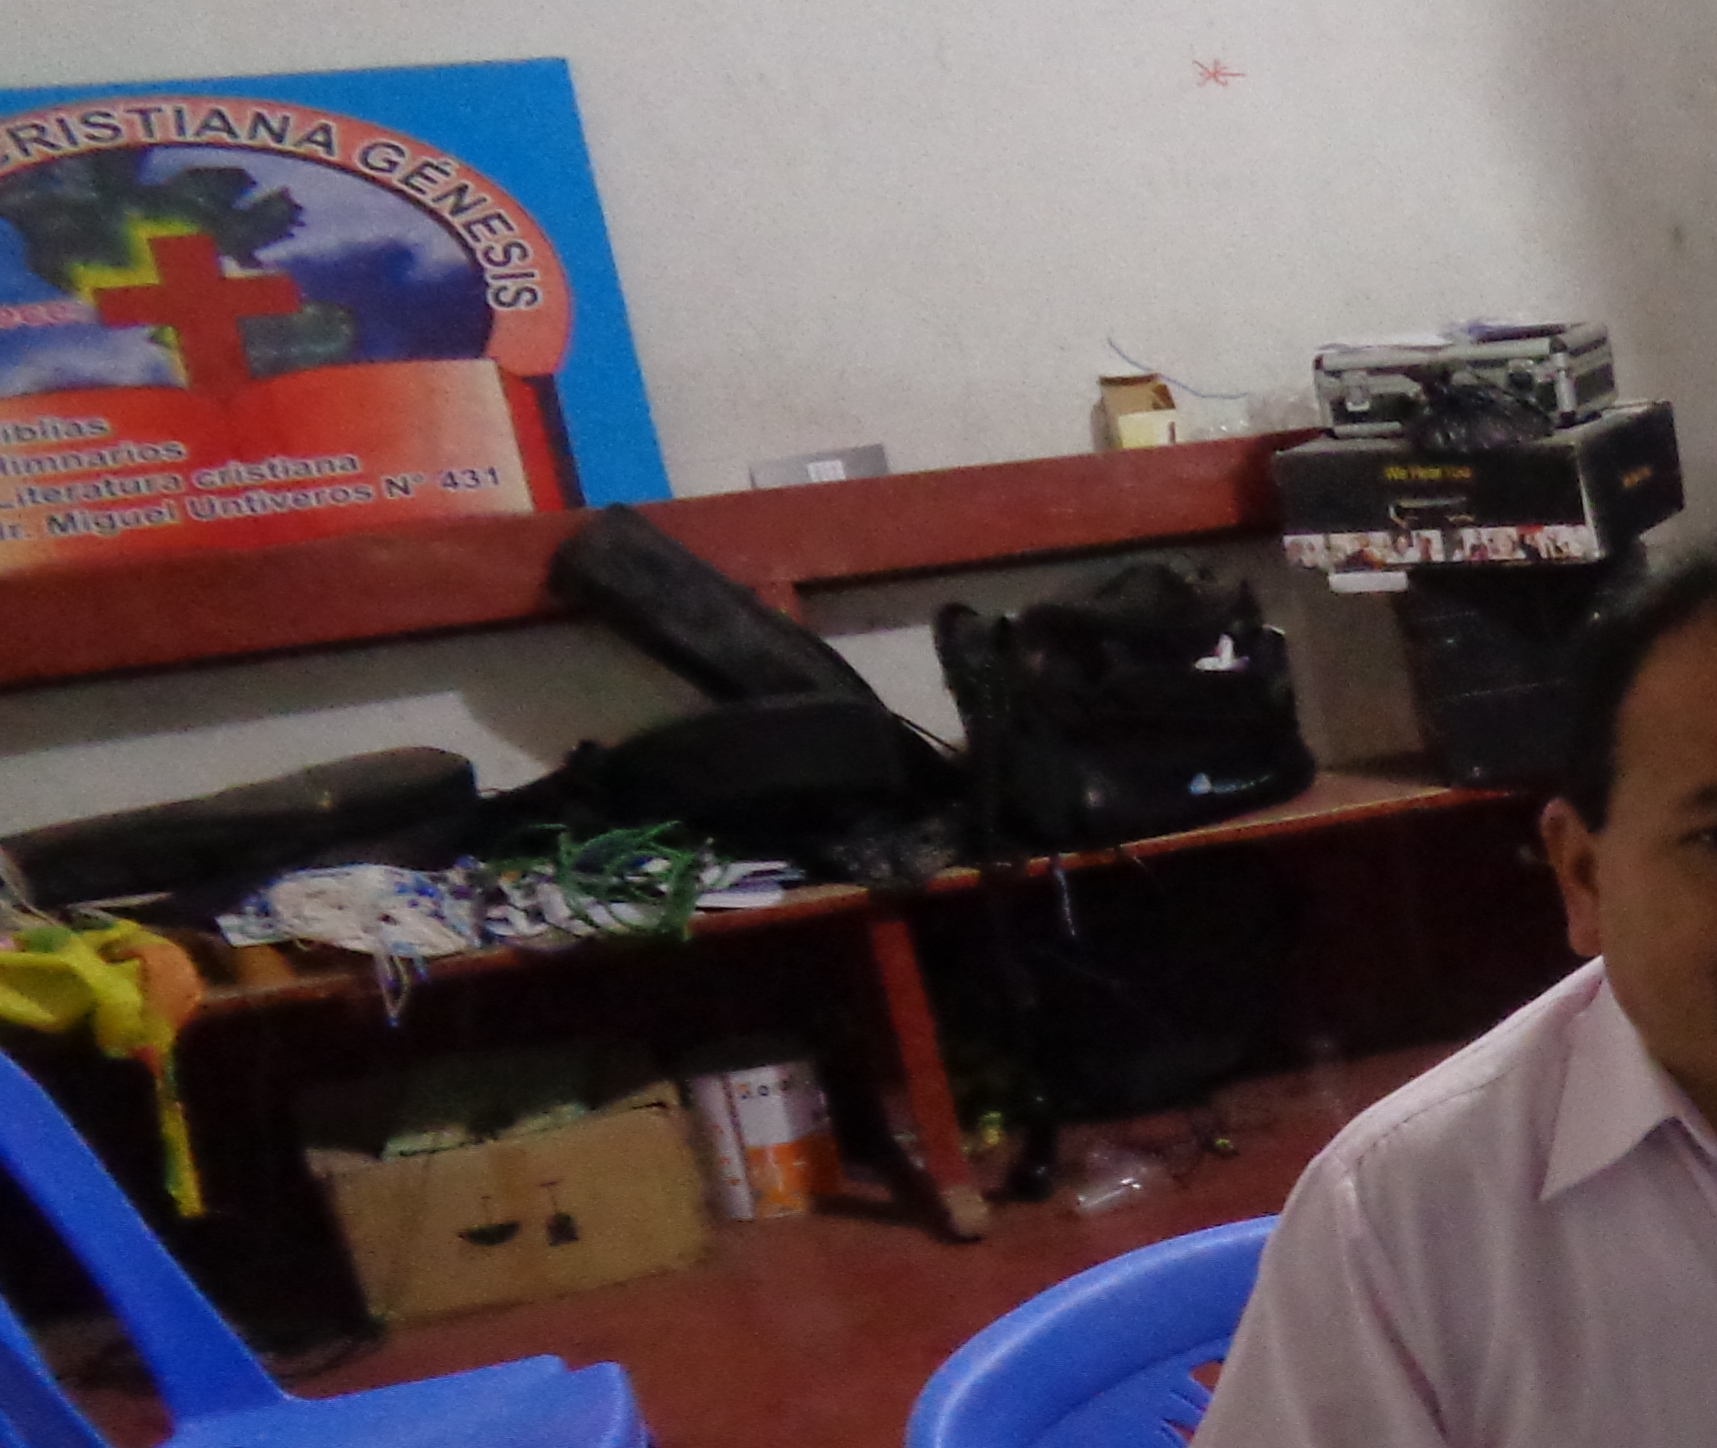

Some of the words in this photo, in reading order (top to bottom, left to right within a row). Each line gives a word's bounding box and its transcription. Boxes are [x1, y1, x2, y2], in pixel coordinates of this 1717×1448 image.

[0, 104, 338, 162] RISTIANA
[356, 139, 542, 311] GÉNESIS
[0, 415, 110, 444] iblias
[192, 454, 361, 489] cristiana
[46, 500, 180, 537] Miguel
[187, 484, 374, 521] Untiveros
[440, 467, 500, 492] 431
